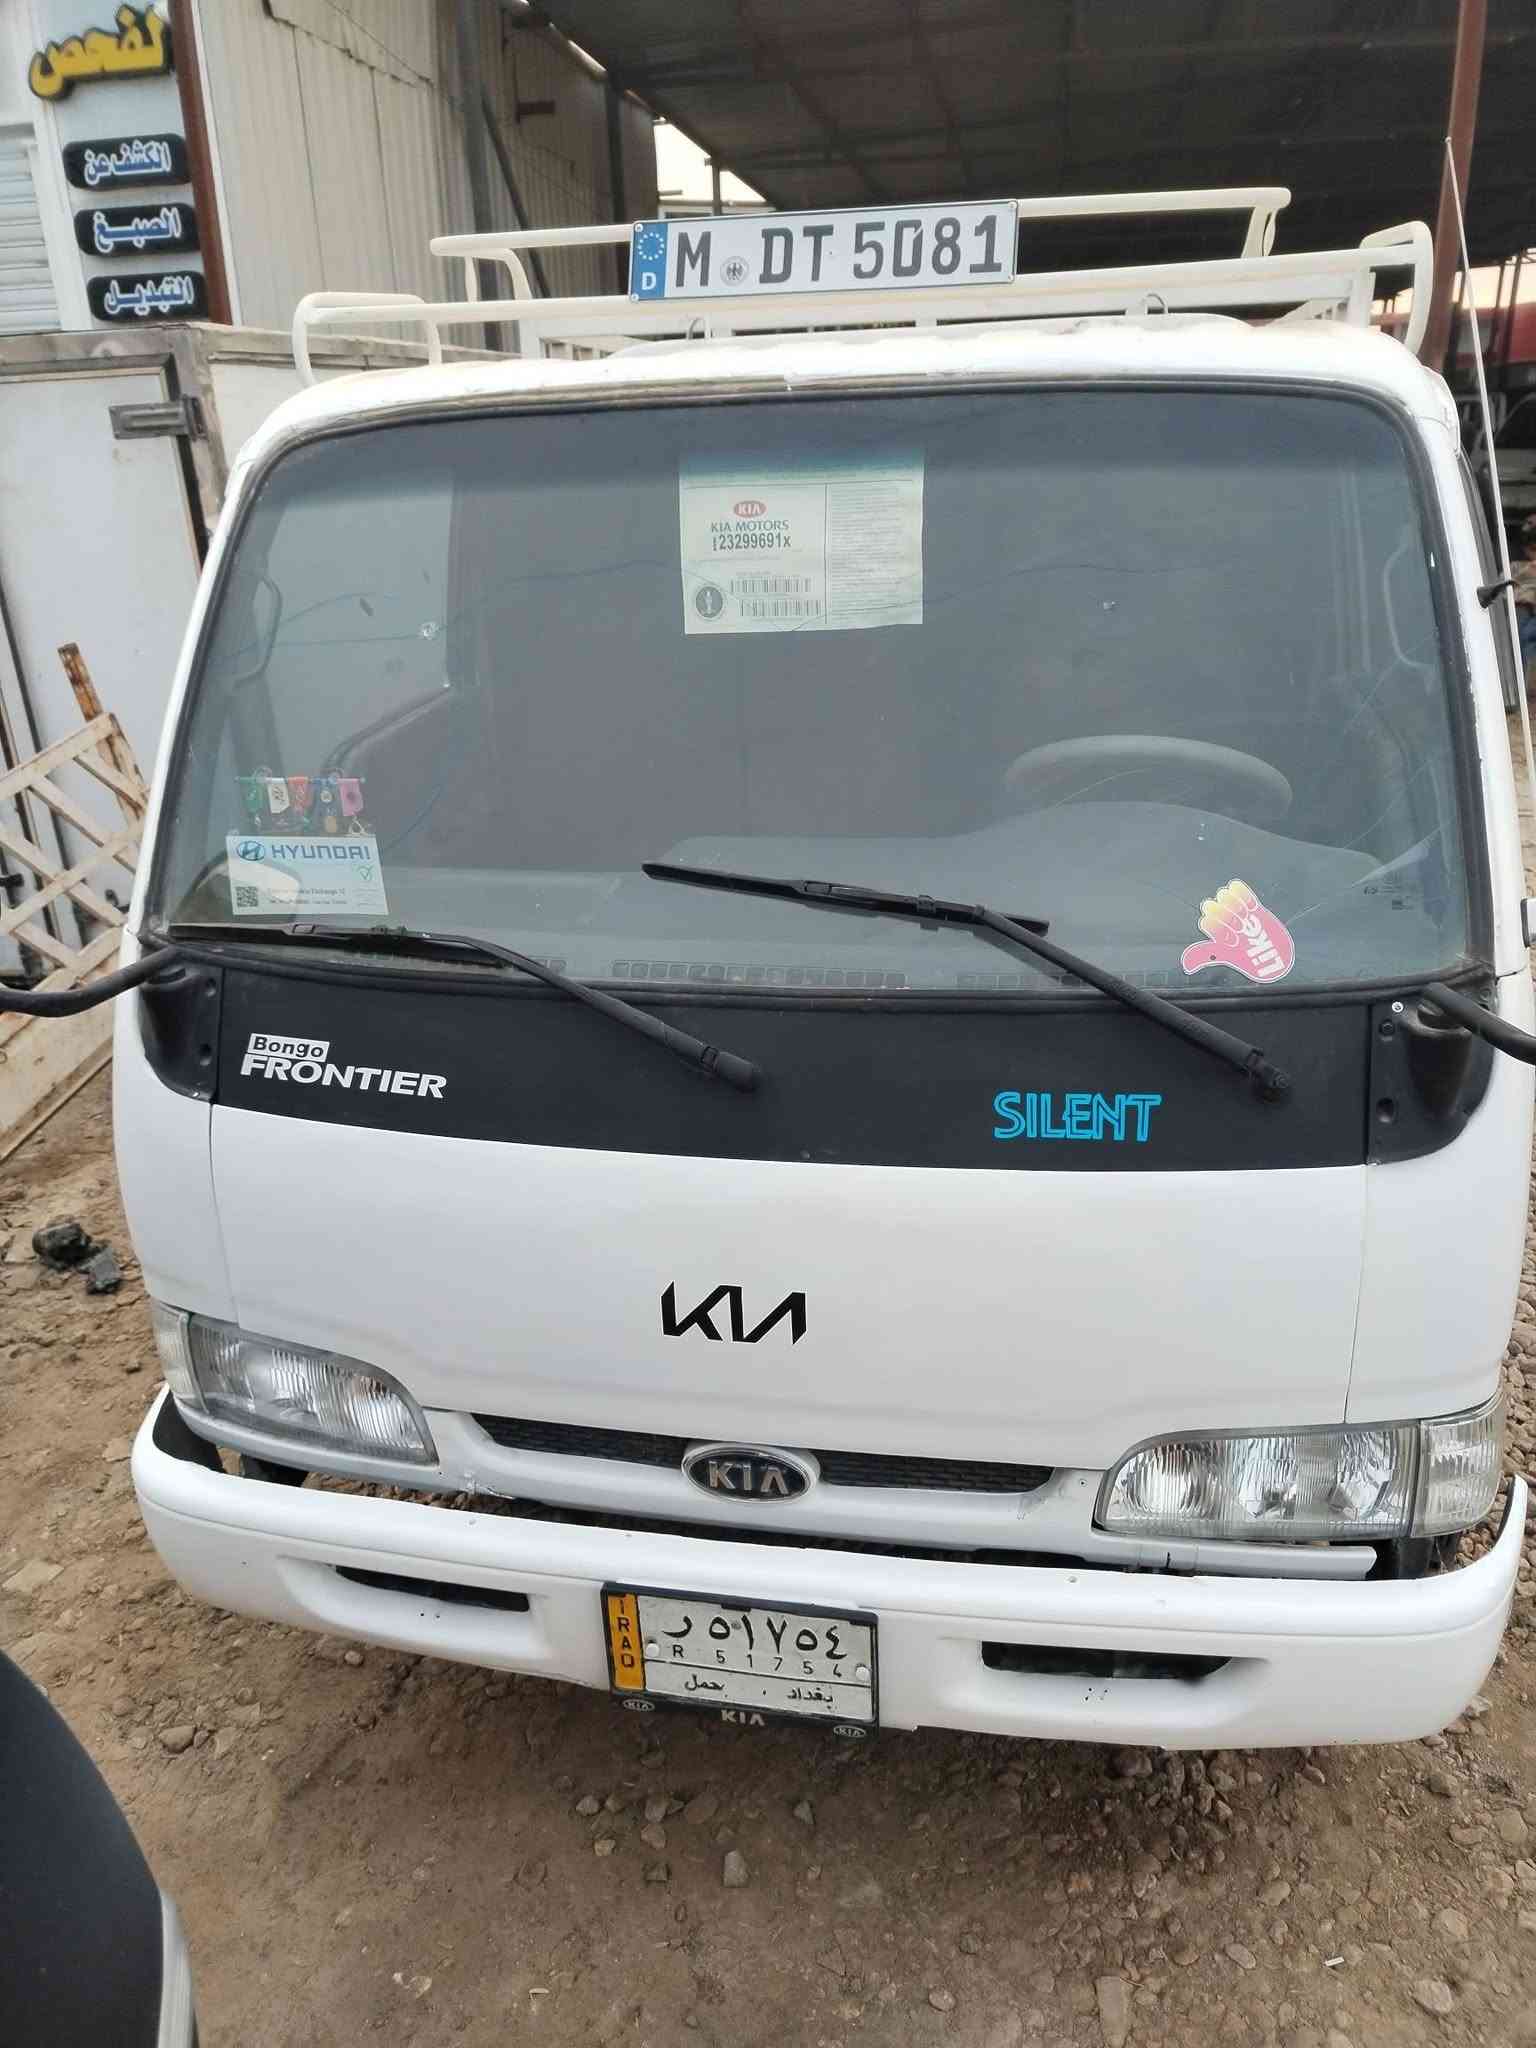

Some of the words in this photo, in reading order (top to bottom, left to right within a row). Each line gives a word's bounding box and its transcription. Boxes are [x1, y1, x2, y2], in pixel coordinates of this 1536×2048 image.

[675, 231, 711, 288] M
[759, 223, 834, 284] DT
[852, 214, 1003, 280] 5081
[641, 272, 657, 290] D
[104, 275, 194, 316] التبديل
[738, 504, 762, 516] KIA
[711, 521, 731, 533] KIA
[735, 520, 790, 532] MOTORS
[271, 844, 371, 860] HYUNDAI
[1240, 912, 1286, 978] Like
[252, 1035, 325, 1058] Bongo
[240, 1053, 447, 1099] FRONTIER
[993, 1091, 1162, 1142] SILENT
[661, 1280, 807, 1345] KIA
[707, 1460, 790, 1496] KIA
[672, 1643, 685, 1659] R
[786, 1686, 834, 1710] بغداد
[721, 1708, 766, 1726] KIA
